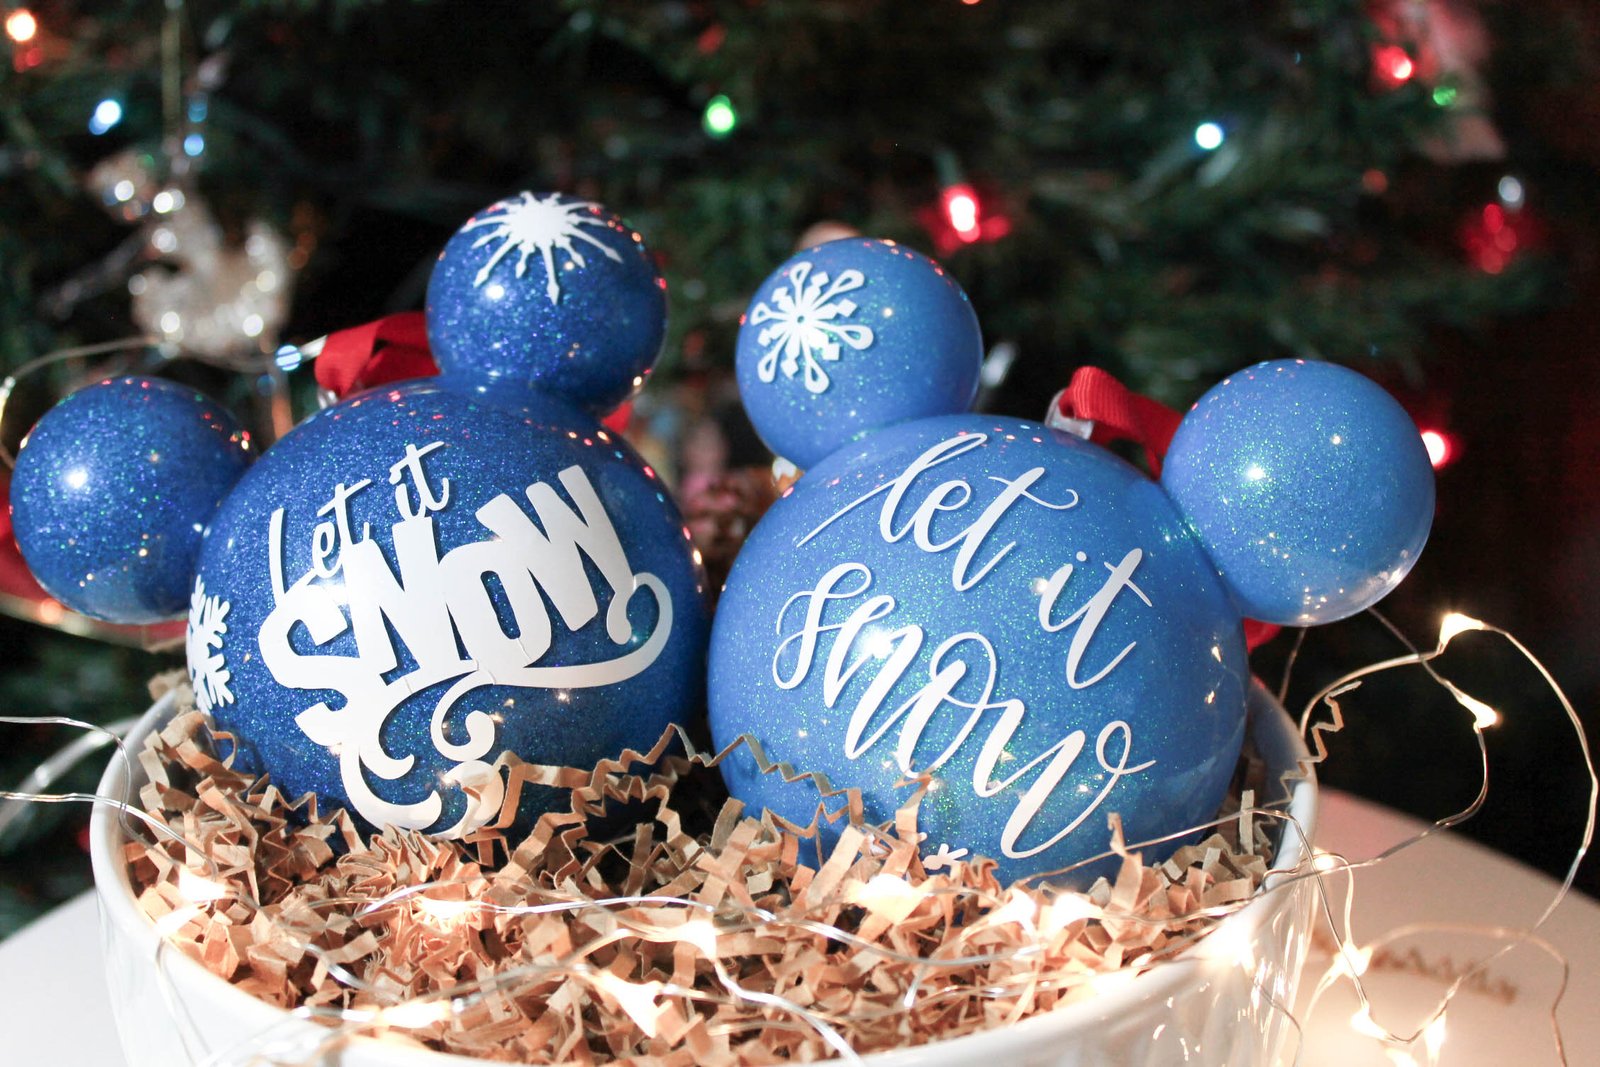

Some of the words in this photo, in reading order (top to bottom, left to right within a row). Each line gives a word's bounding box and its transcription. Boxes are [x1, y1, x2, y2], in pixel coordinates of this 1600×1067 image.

[389, 440, 450, 521] it
[796, 432, 1078, 592] let
[1037, 547, 1153, 690] it
[772, 562, 1157, 860] snow
